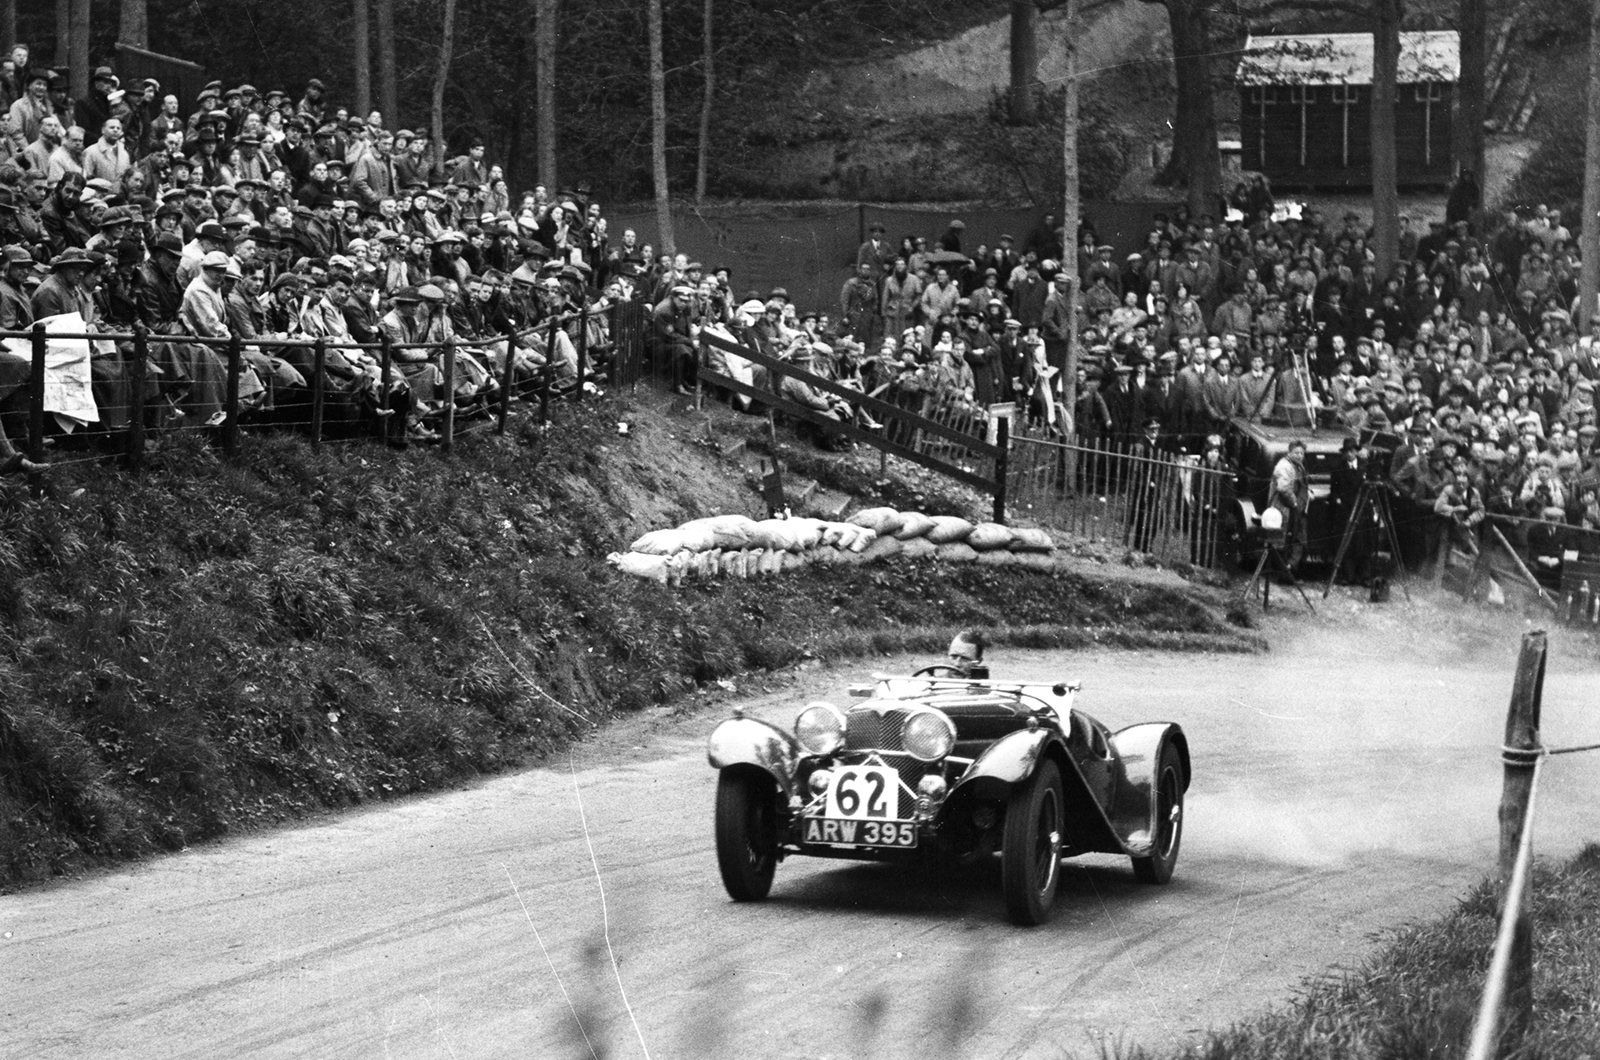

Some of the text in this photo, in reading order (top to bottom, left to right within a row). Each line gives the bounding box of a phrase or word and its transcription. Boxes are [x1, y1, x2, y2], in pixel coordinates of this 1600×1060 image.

[836, 771, 887, 818] 62
[807, 819, 913, 845] ARW 395
